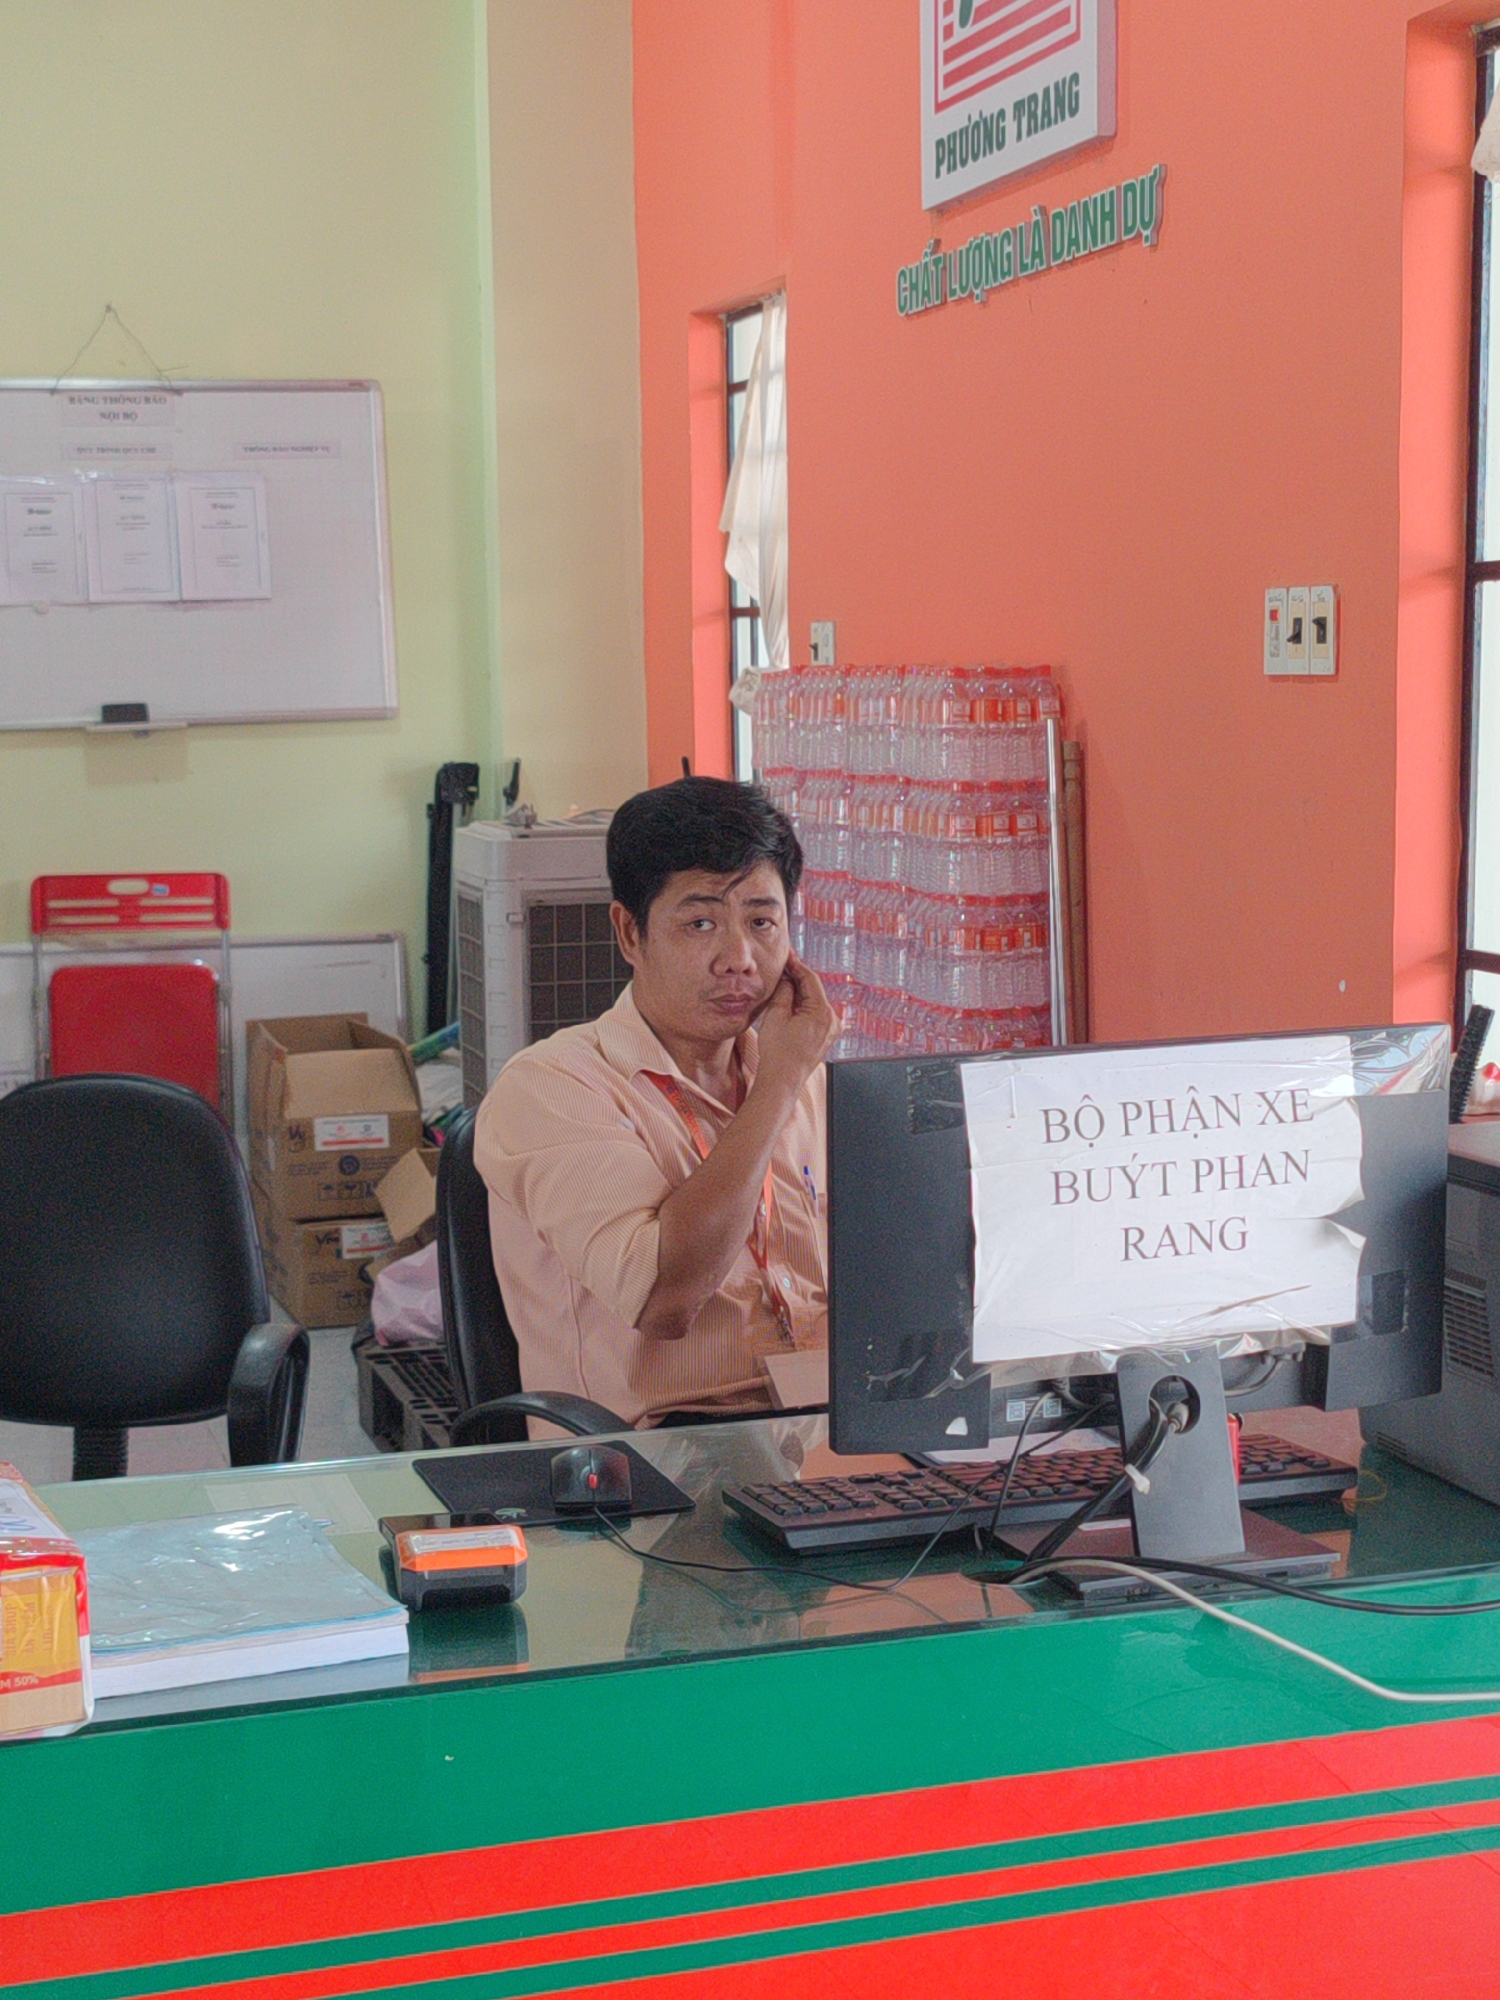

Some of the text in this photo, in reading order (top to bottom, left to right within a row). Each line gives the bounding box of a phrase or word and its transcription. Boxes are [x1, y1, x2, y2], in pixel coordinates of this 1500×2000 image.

[934, 71, 1080, 180] PHƯƠNG TRANG
[896, 164, 1160, 316] CHẤT LƯỢNG LÀ DANH DỰ
[1039, 1086, 1315, 1148] BỘ PHẬN XE
[1051, 1149, 1312, 1205] BUÝT PHAN
[1120, 1216, 1249, 1262] RANG
[0, 1675, 40, 1690] M 50%
